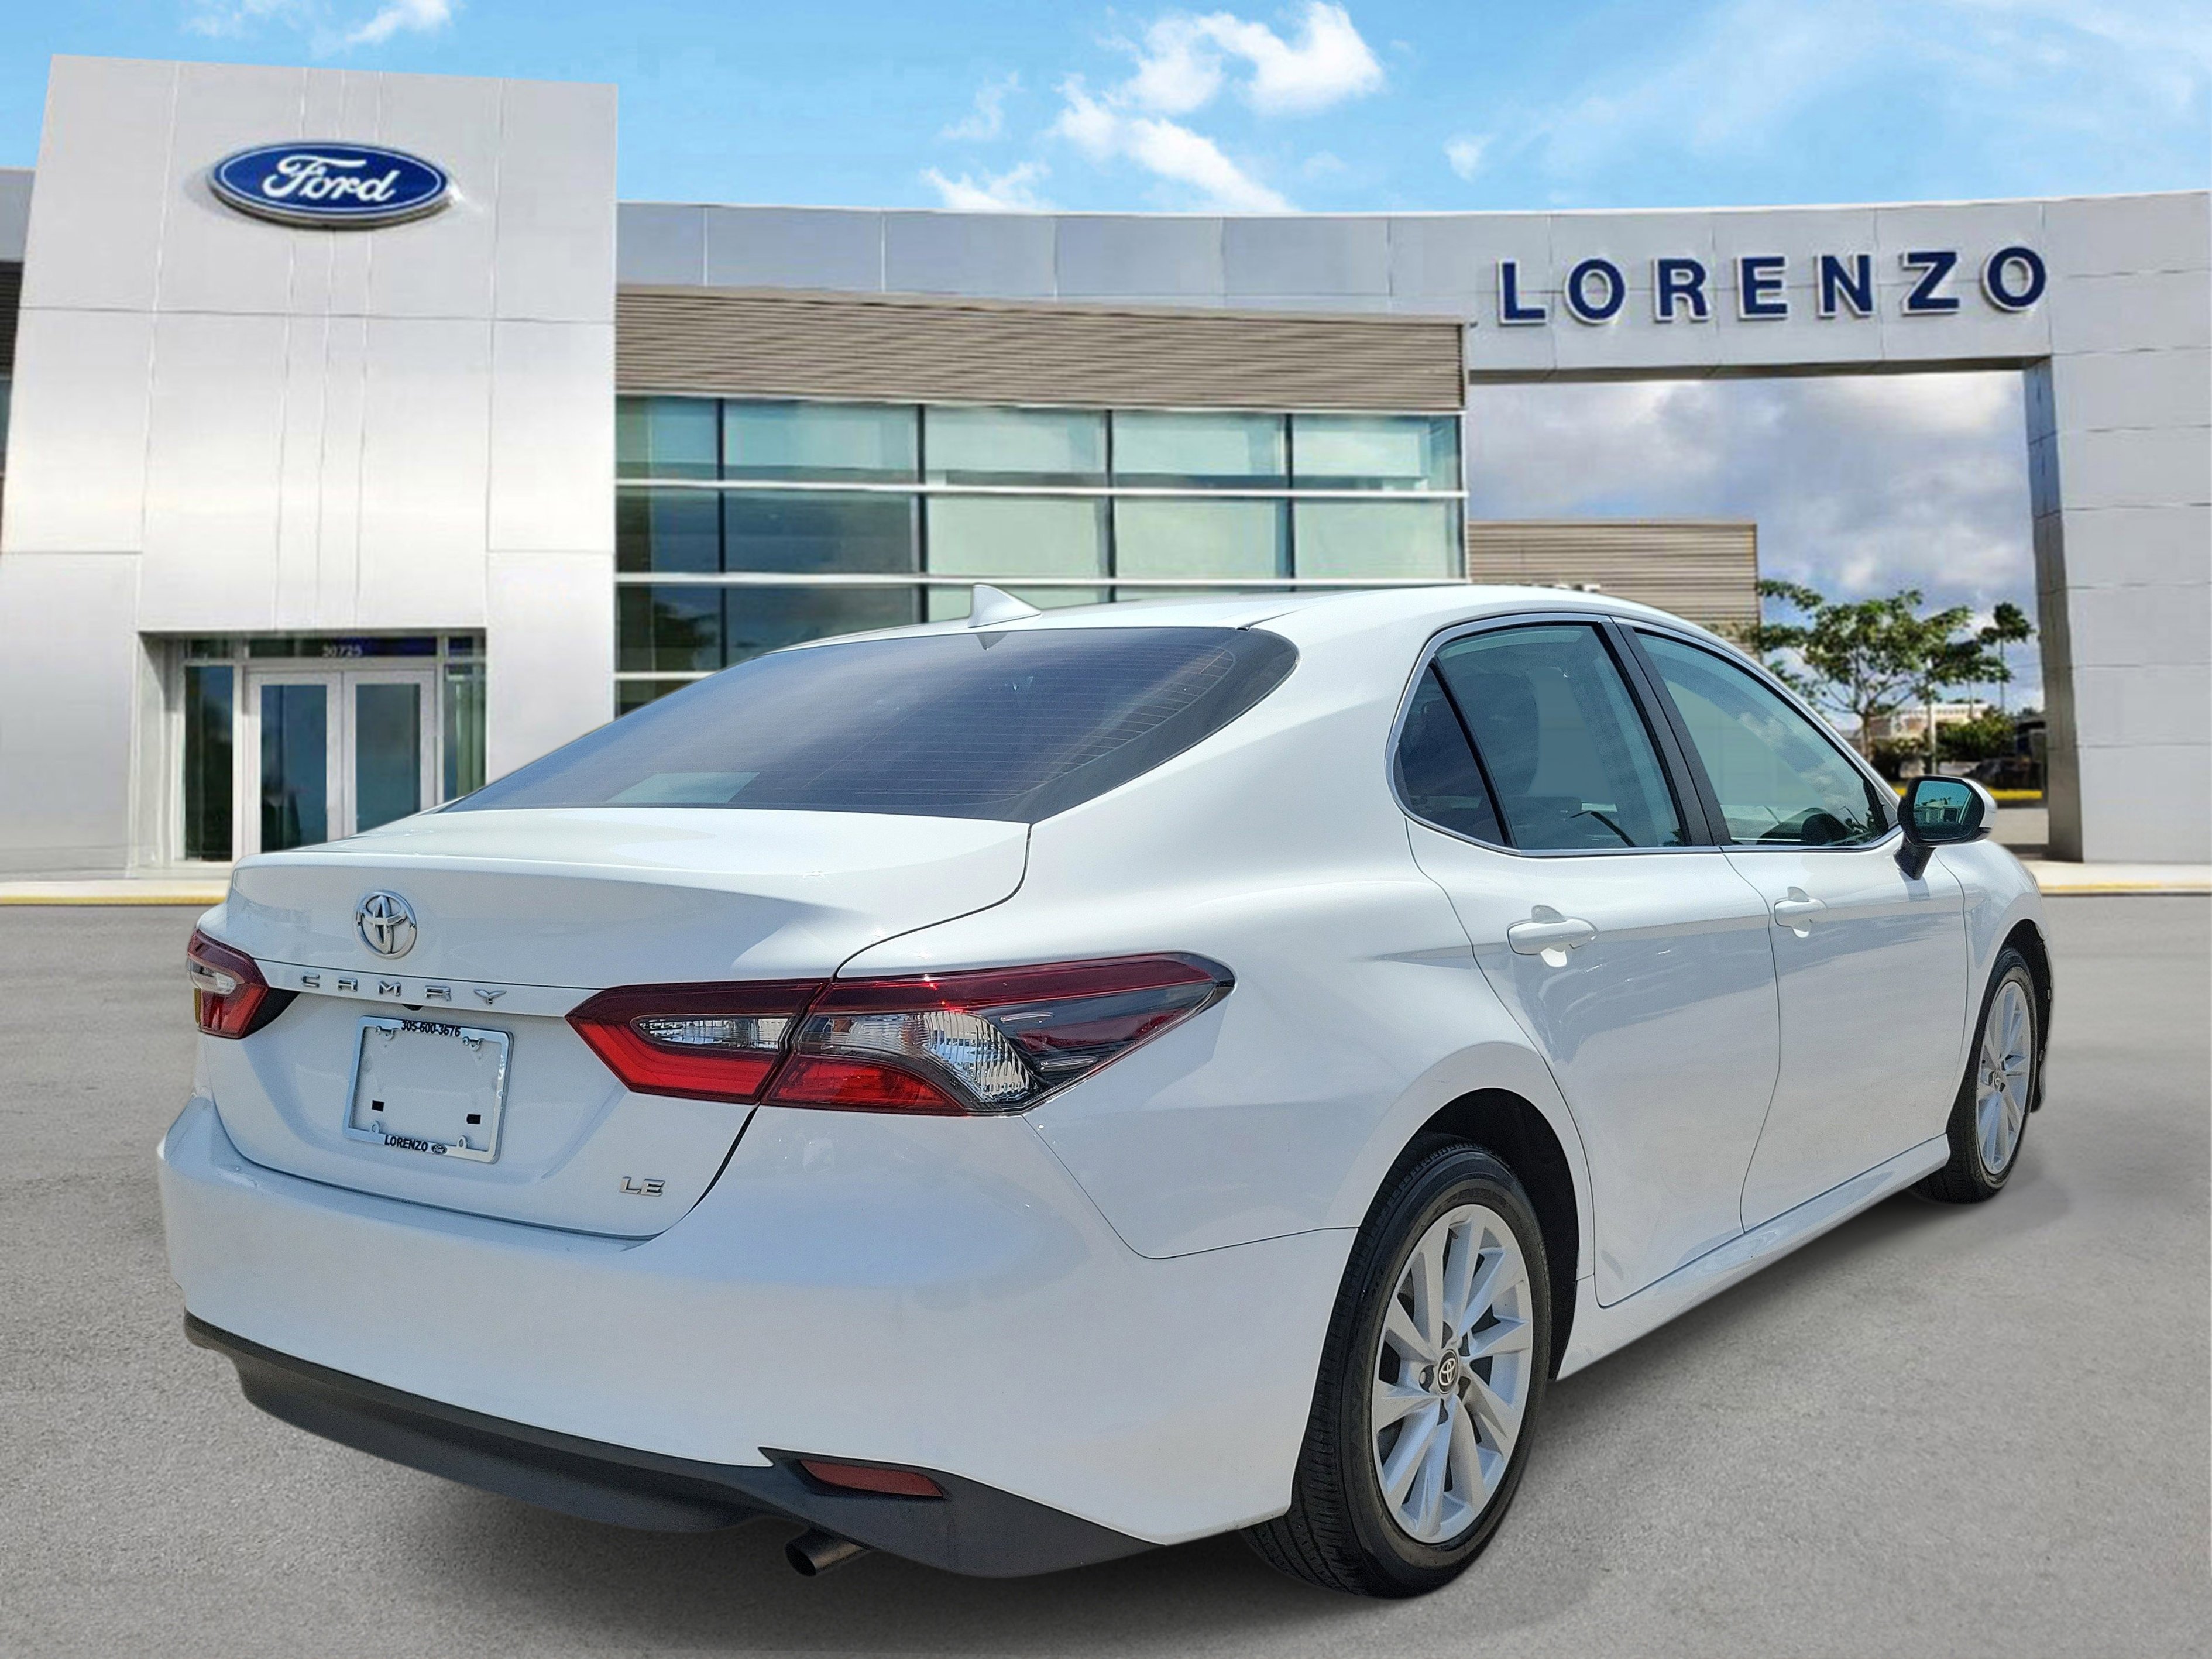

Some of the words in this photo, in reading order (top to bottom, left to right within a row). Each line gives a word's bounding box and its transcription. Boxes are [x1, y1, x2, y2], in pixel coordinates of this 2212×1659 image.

[262, 155, 400, 201] Ford
[1497, 246, 2047, 322] LORENZO
[300, 971, 507, 1004] CAMRY
[401, 1020, 461, 1037] 305-600-3676
[384, 1135, 428, 1152] LORENZO
[620, 1176, 665, 1197] LE
